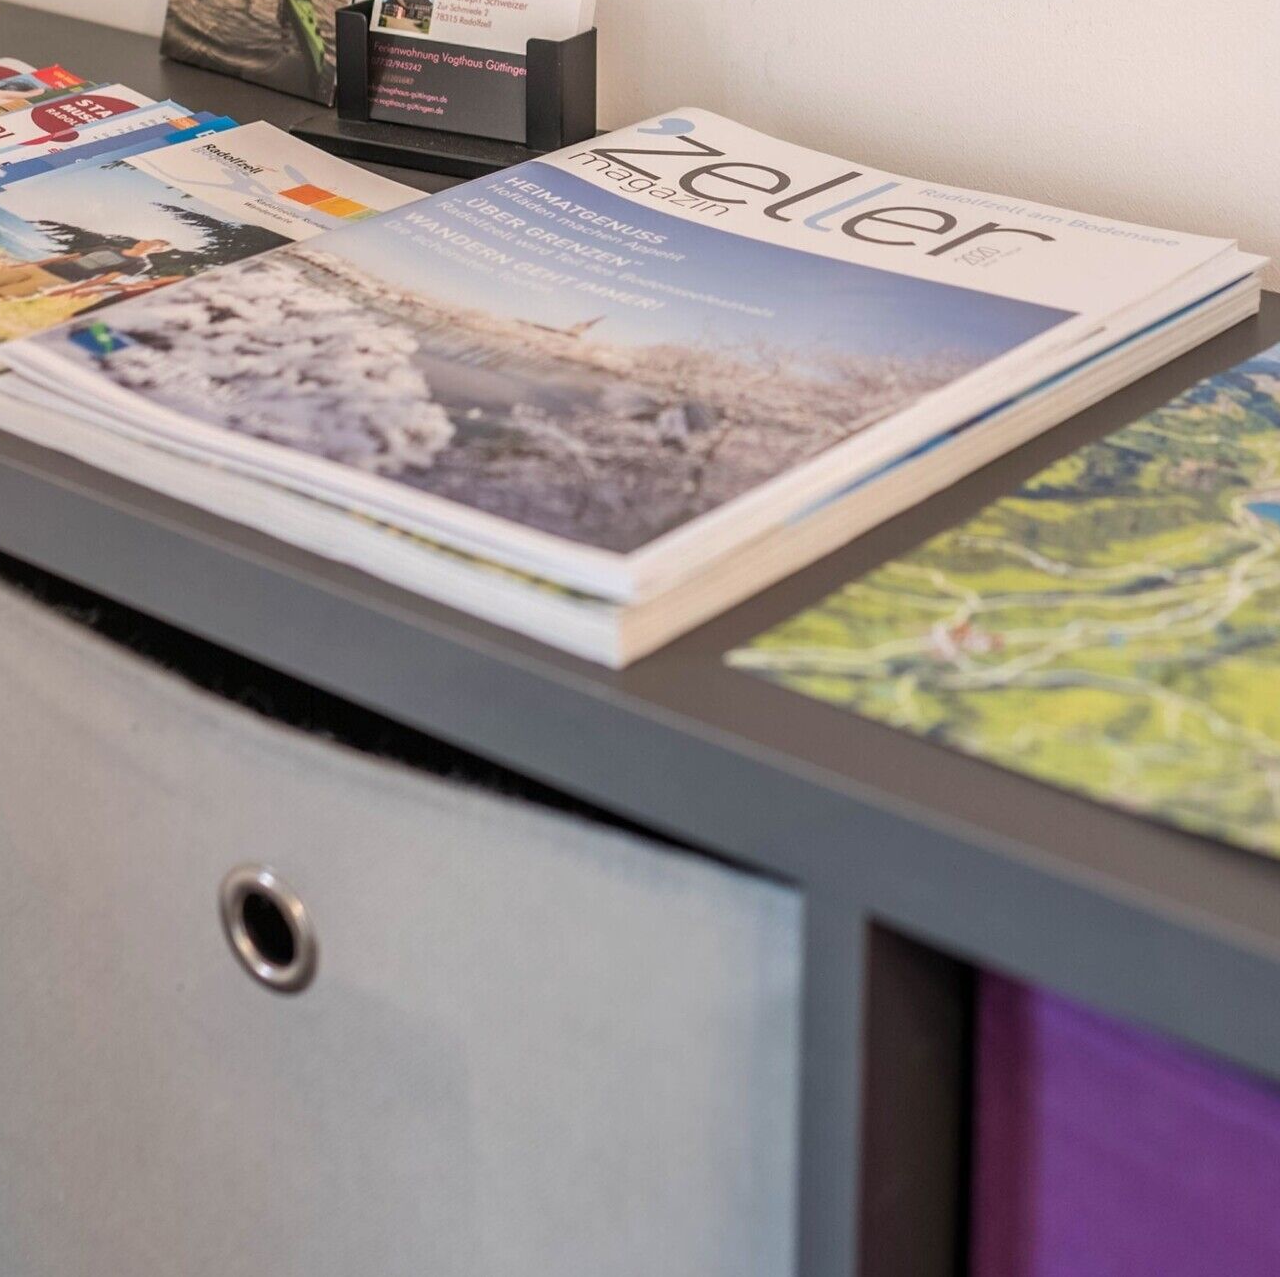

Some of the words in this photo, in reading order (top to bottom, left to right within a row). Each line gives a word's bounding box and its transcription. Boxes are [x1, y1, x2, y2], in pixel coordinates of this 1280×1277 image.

[484, 8, 489, 17] 2
[374, 40, 439, 64] Ferienwohnung
[442, 52, 483, 67] Vogthaus
[202, 143, 264, 174] Radolfzell
[568, 150, 730, 218] magazin
[436, 200, 515, 242] Radolfzell
[486, 183, 557, 220] Hofläden
[557, 217, 623, 244] machen
[622, 240, 688, 262] Appetit
[504, 176, 668, 244] HEIMATGENUSS
[919, 187, 1025, 216] Radolfzell
[1026, 211, 1065, 225] am
[1067, 218, 1181, 248] Bodensee
[403, 211, 515, 265] WANDERN
[513, 259, 578, 286] GEHT
